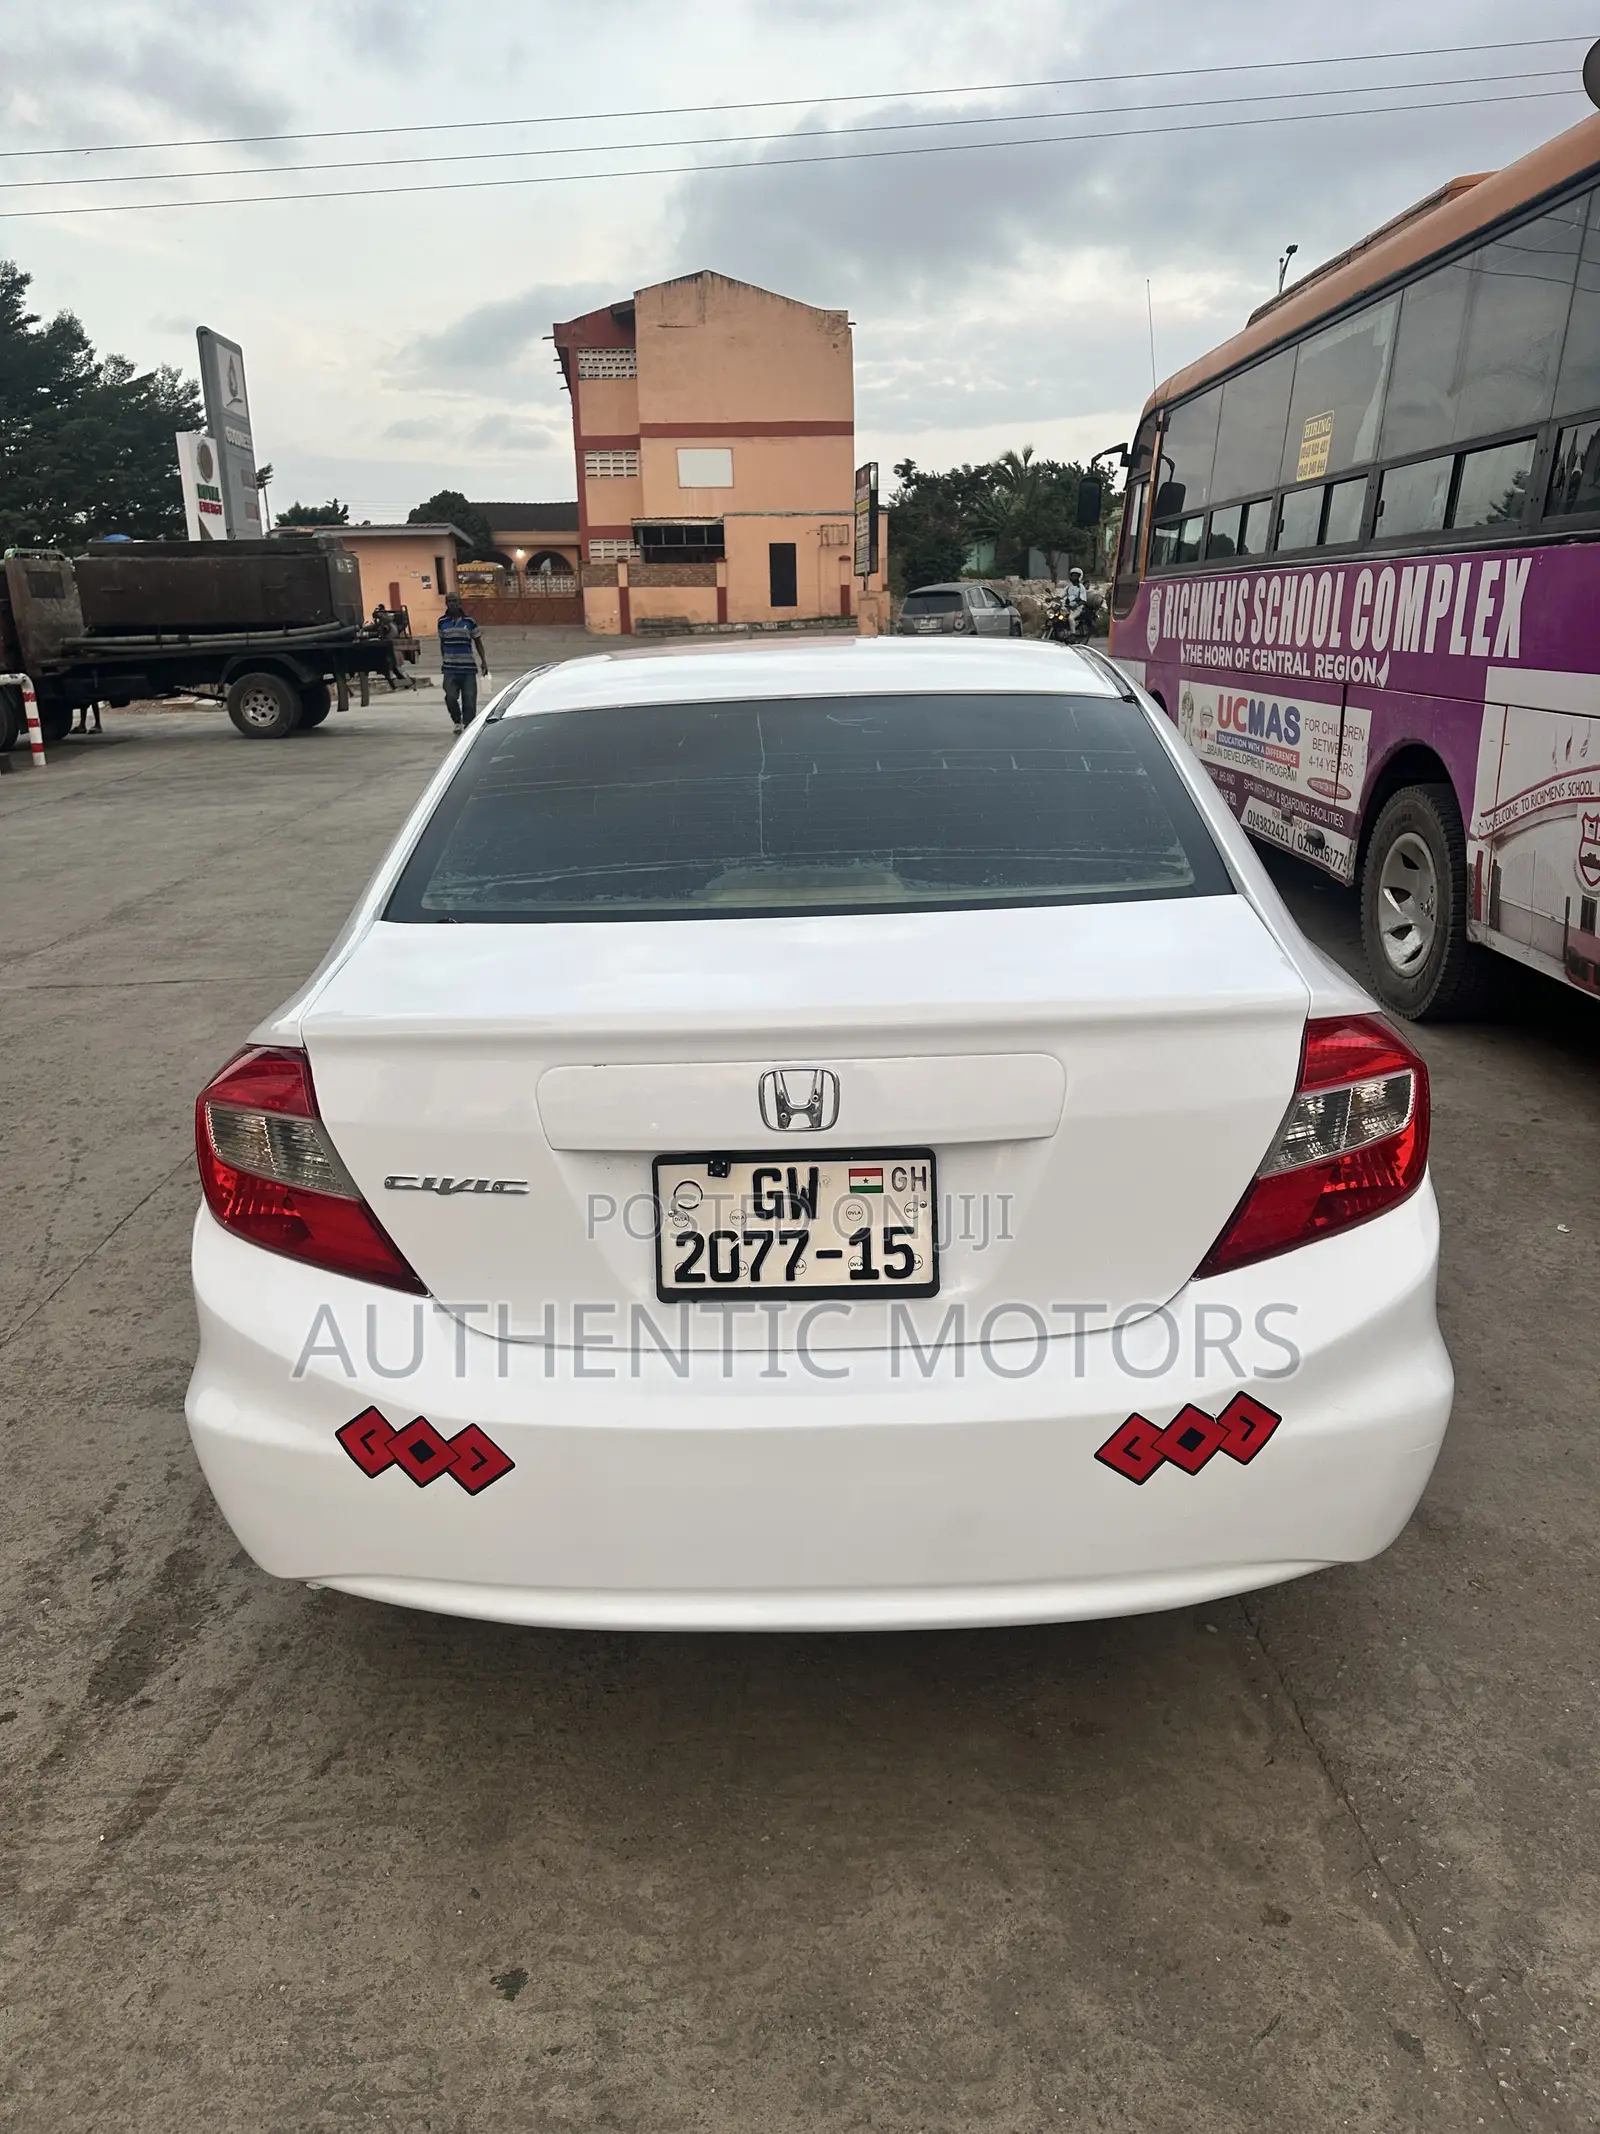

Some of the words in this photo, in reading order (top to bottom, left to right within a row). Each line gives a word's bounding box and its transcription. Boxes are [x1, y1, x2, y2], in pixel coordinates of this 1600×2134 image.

[1303, 416, 1332, 439] HIRING
[1163, 577, 1250, 643] RICHMENS
[1251, 571, 1345, 648] SCHOOL
[1351, 557, 1532, 659] COMPLEX
[1185, 643, 1203, 663] THE
[1204, 645, 1232, 667] HORN
[1235, 647, 1250, 669] OF
[1252, 648, 1311, 677] CENTRAL
[1314, 653, 1377, 684] REGION
[1217, 694, 1301, 746] UCMAS
[1304, 717, 1320, 733] FOR
[1321, 721, 1366, 741] CHILDREN
[1206, 743, 1223, 757] BRAIN
[1265, 761, 1298, 782] PROGRAM
[1218, 731, 1248, 748] EDUCATION
[1248, 741, 1260, 753] WITH
[1260, 746, 1265, 754] A
[1265, 746, 1297, 764] DIFFERENCE
[1312, 737, 1354, 758] BETWEEN
[1308, 755, 1324, 771] 4-14
[1325, 758, 1354, 777] YEARS
[1520, 797, 1530, 812] TO
[1567, 780, 1595, 797] SCHOOL
[384, 1174, 530, 1195] CIVIC
[752, 1167, 819, 1220] GW
[891, 1166, 927, 1192] GH
[674, 1226, 915, 1283] 2077-15
